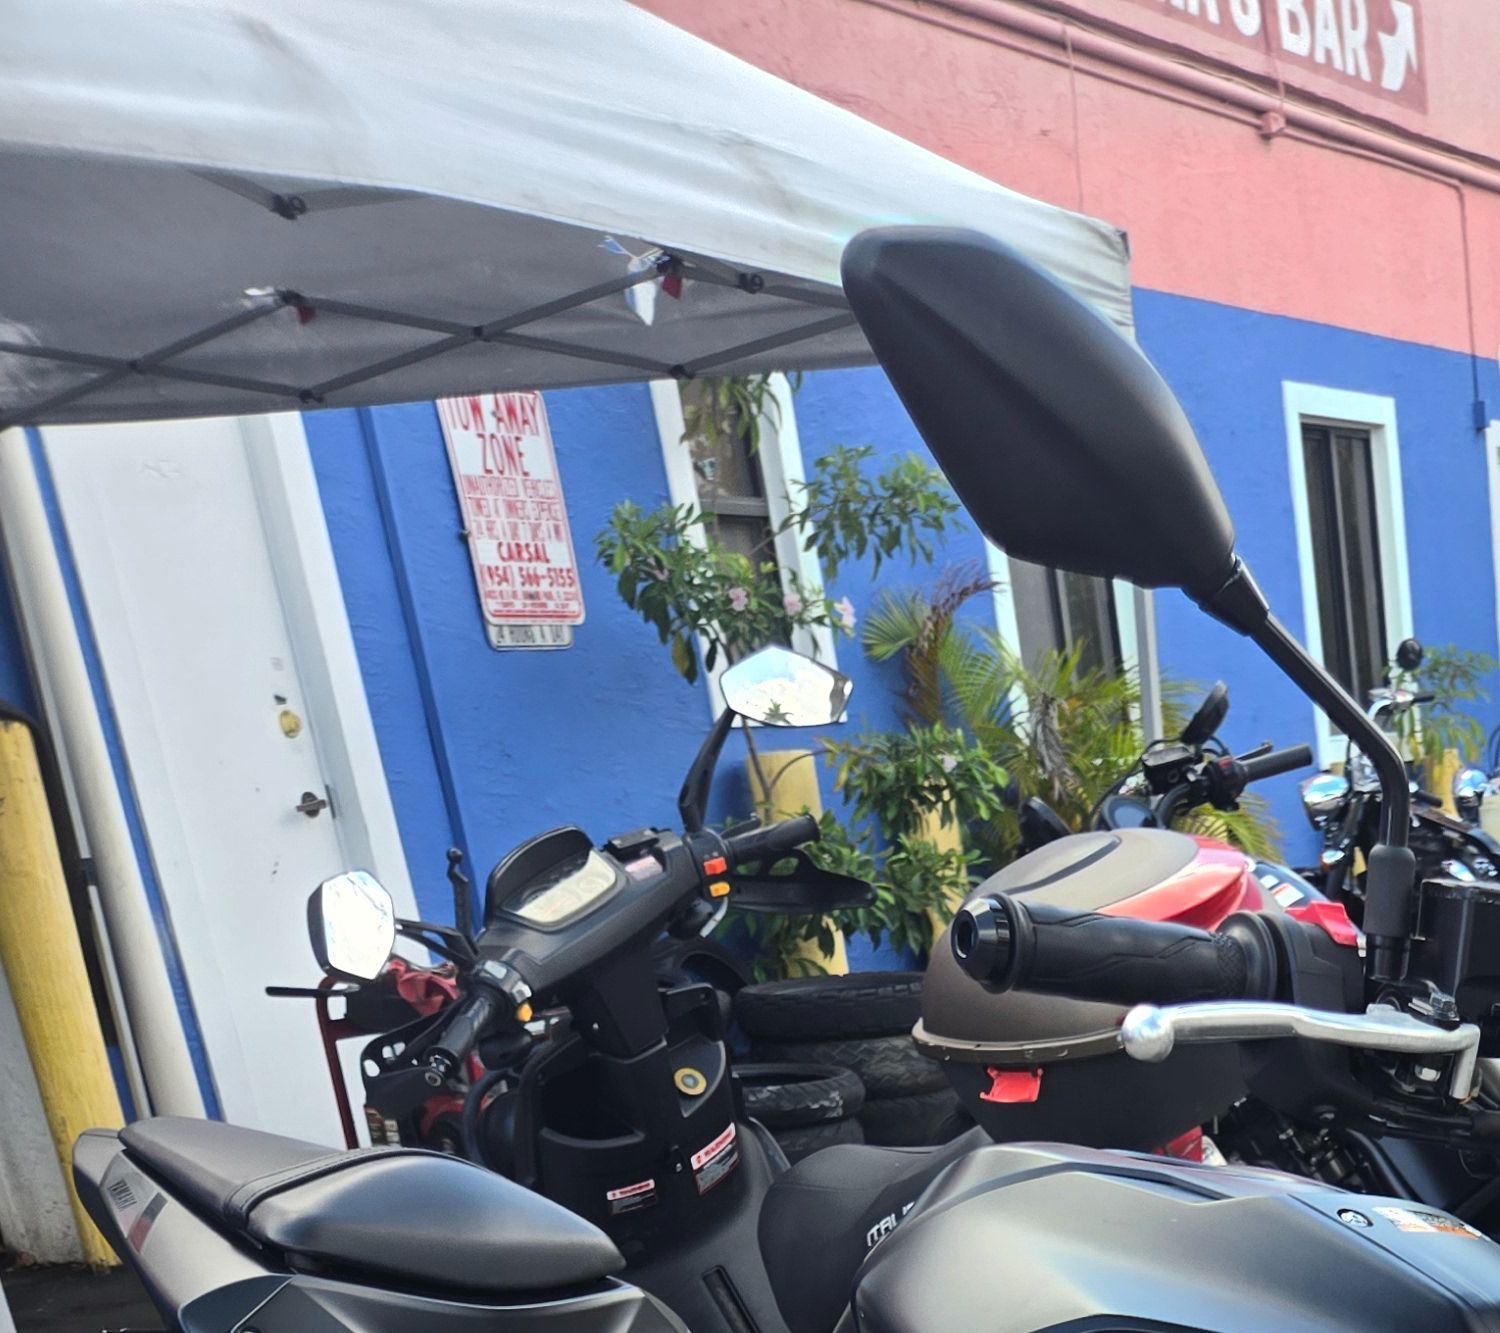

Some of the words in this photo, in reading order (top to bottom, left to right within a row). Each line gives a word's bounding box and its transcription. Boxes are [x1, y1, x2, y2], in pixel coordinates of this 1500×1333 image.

[1277, 0, 1371, 82] BAR
[494, 391, 541, 436] AWAY
[476, 432, 530, 477] ZONE
[497, 541, 550, 563] CARSAL
